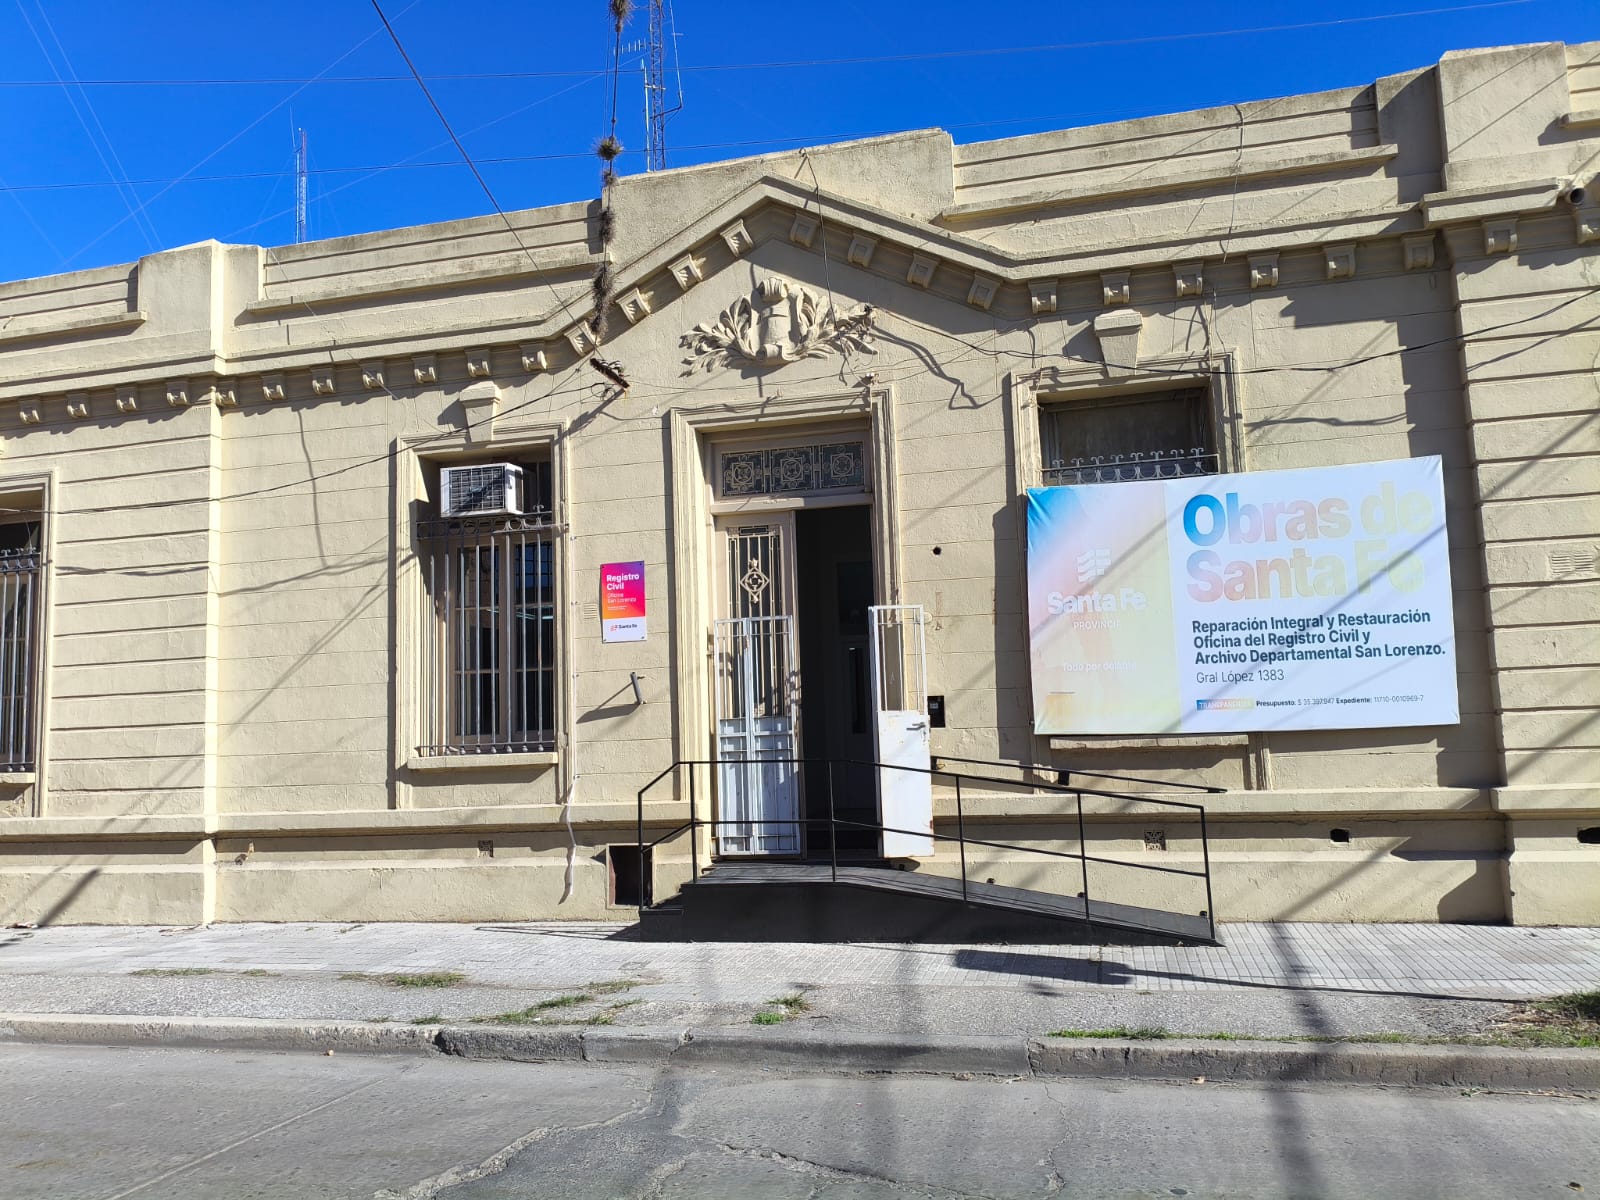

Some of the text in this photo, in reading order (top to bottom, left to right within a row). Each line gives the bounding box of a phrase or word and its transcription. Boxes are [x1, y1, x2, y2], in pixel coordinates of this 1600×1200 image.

[1183, 481, 1433, 547] Obras de
[606, 573, 640, 583] Registro
[1186, 539, 1424, 603] Santa Fe
[606, 582, 624, 591] Civil
[1047, 587, 1147, 614] Santa Fe
[1072, 620, 1121, 630] PROVINCI
[1192, 609, 1431, 638] Reparación Integral y Restauración
[1193, 628, 1371, 649] Oficina del Registro Civil y
[1195, 643, 1446, 665] Archivo Departamental San Lorenzo.
[1196, 669, 1285, 685] Gral López 1383
[1256, 699, 1297, 708] Presupuesto:
